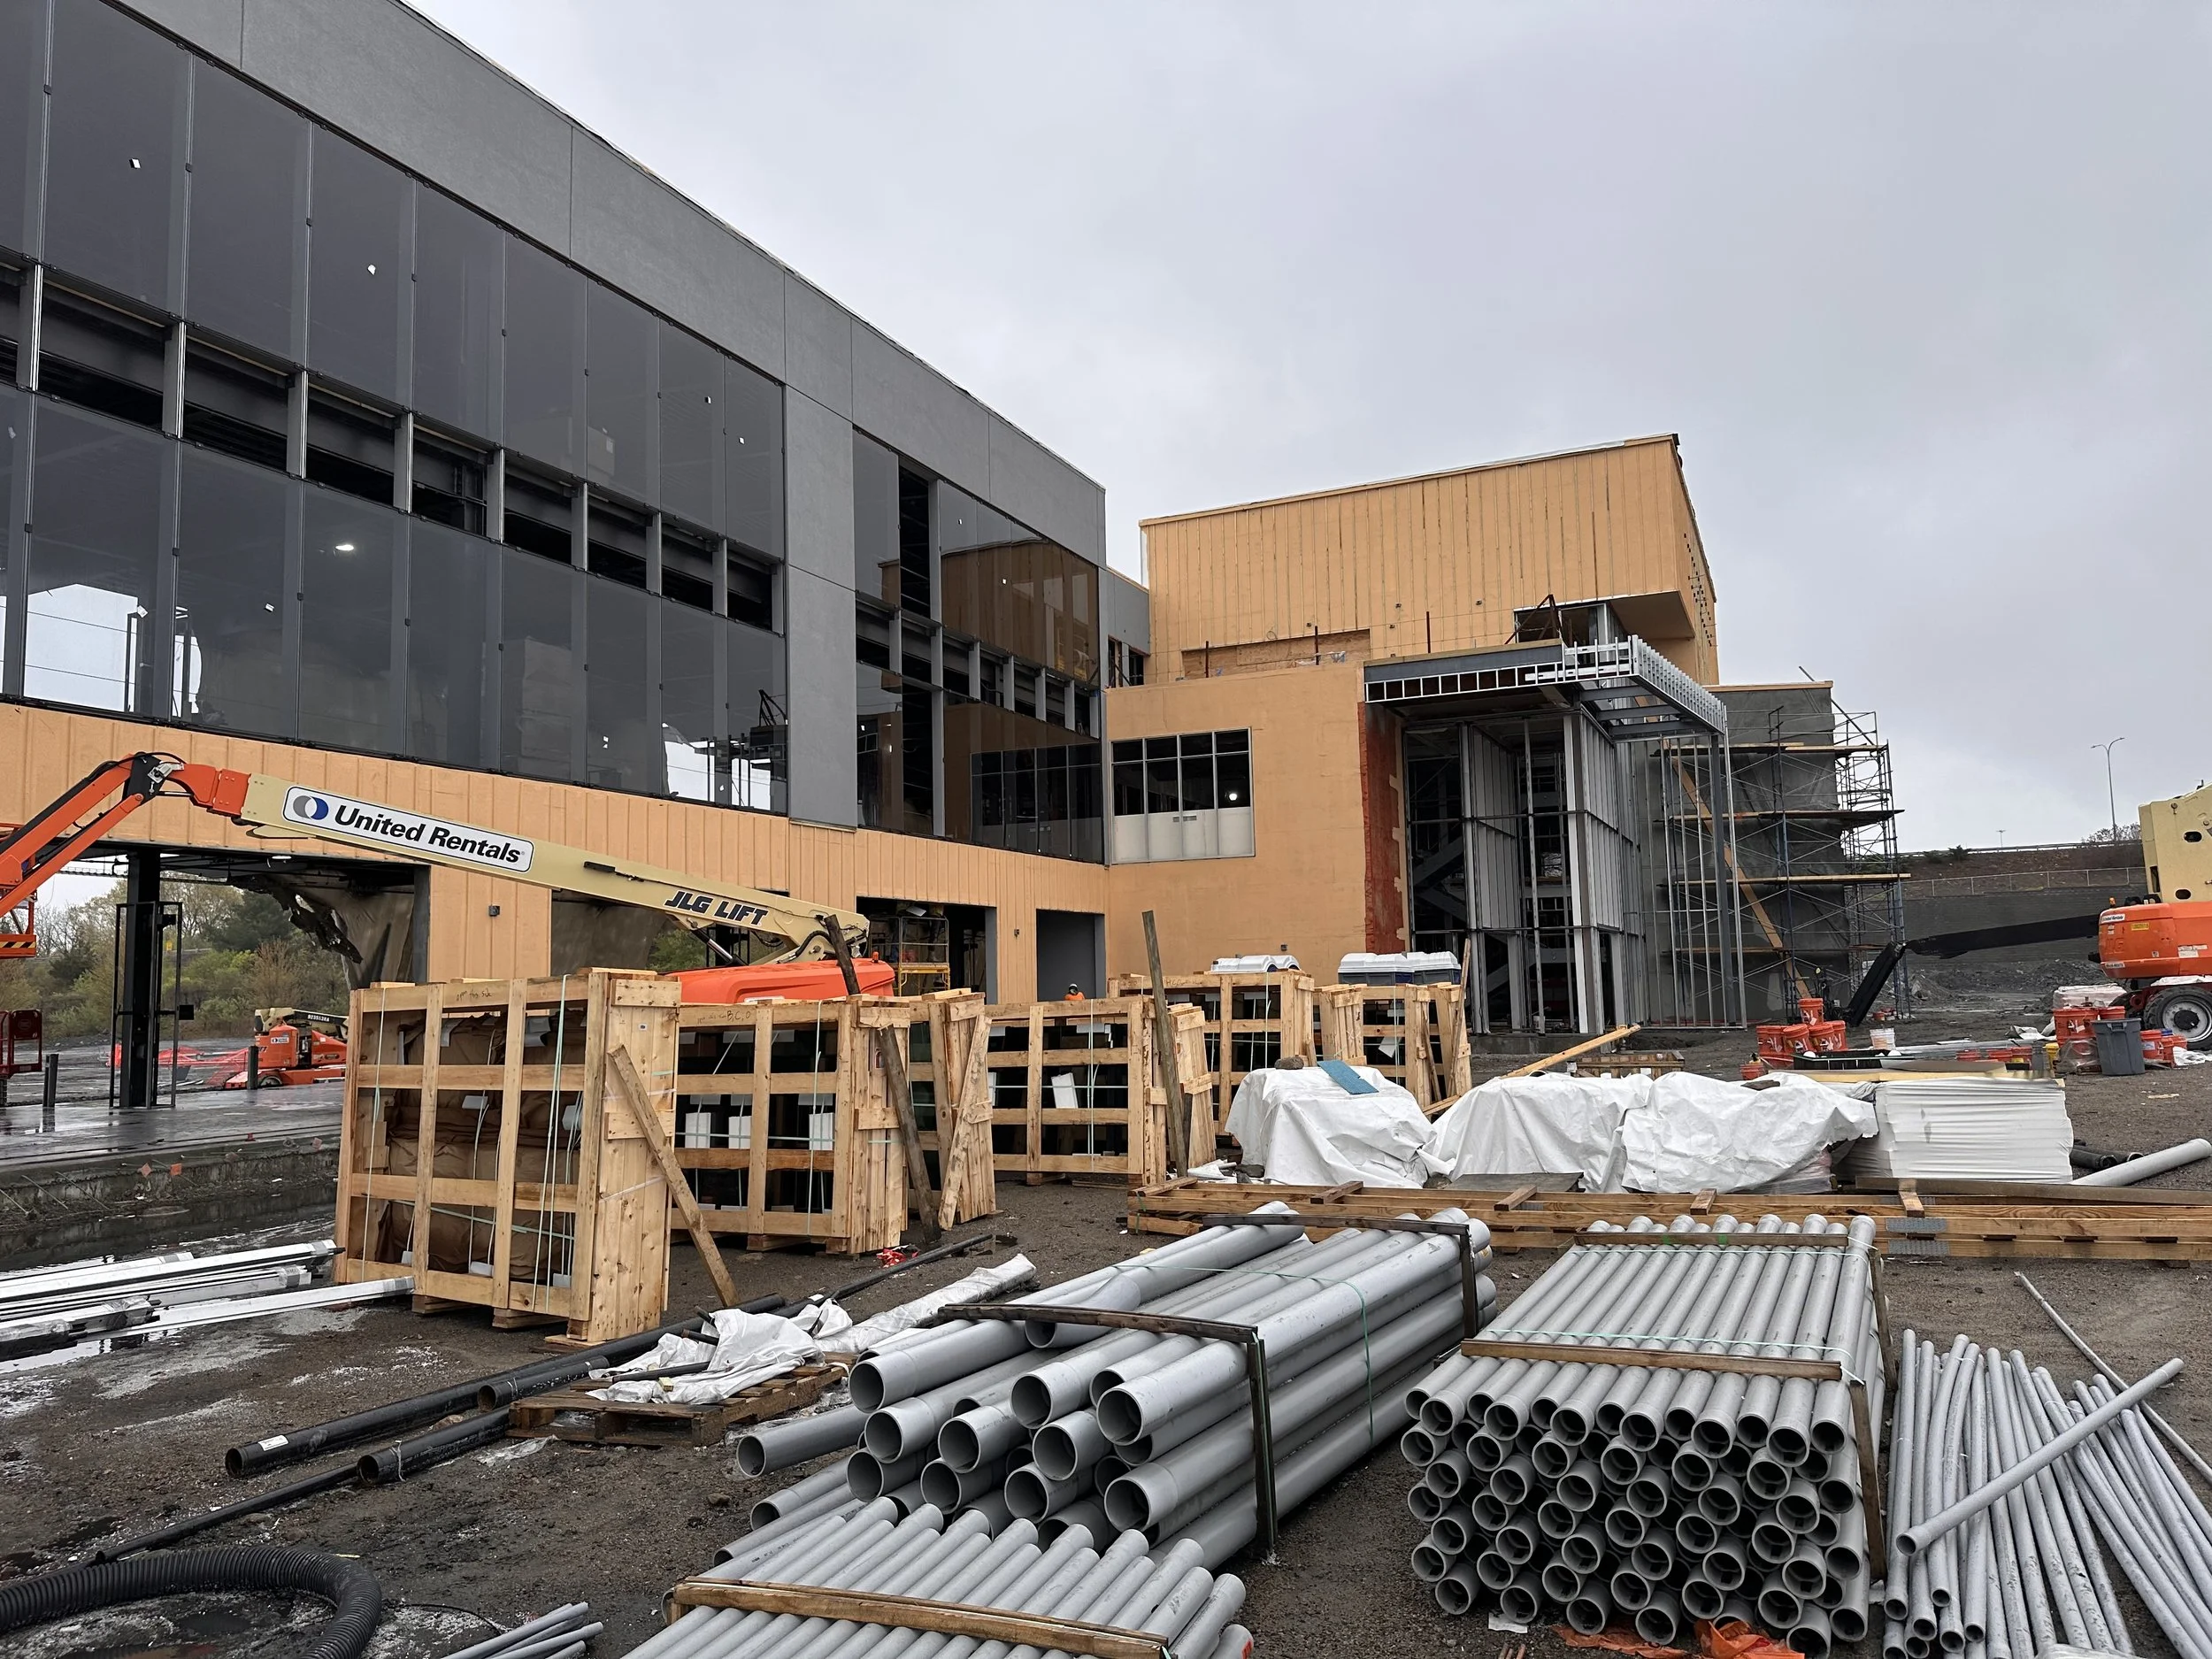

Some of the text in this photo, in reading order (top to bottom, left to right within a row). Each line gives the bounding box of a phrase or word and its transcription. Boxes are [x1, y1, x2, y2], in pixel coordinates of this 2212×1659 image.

[334, 804, 520, 864] United Rentals
[664, 890, 769, 926] JLG LIFT
